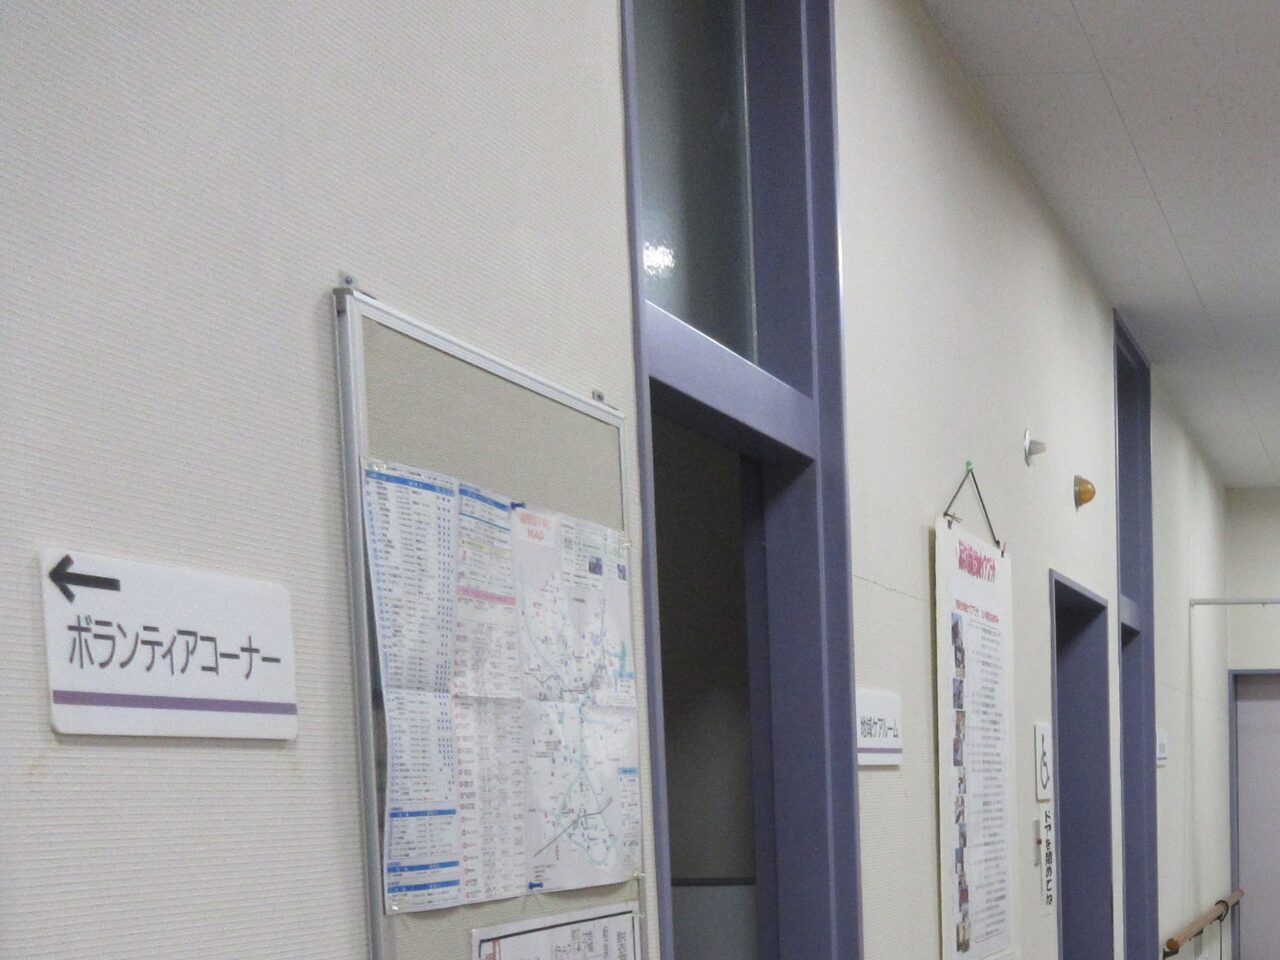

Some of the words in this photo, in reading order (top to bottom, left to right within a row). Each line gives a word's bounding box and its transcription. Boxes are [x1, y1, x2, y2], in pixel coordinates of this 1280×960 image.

[67, 614, 281, 680] ボランティアコーナー
